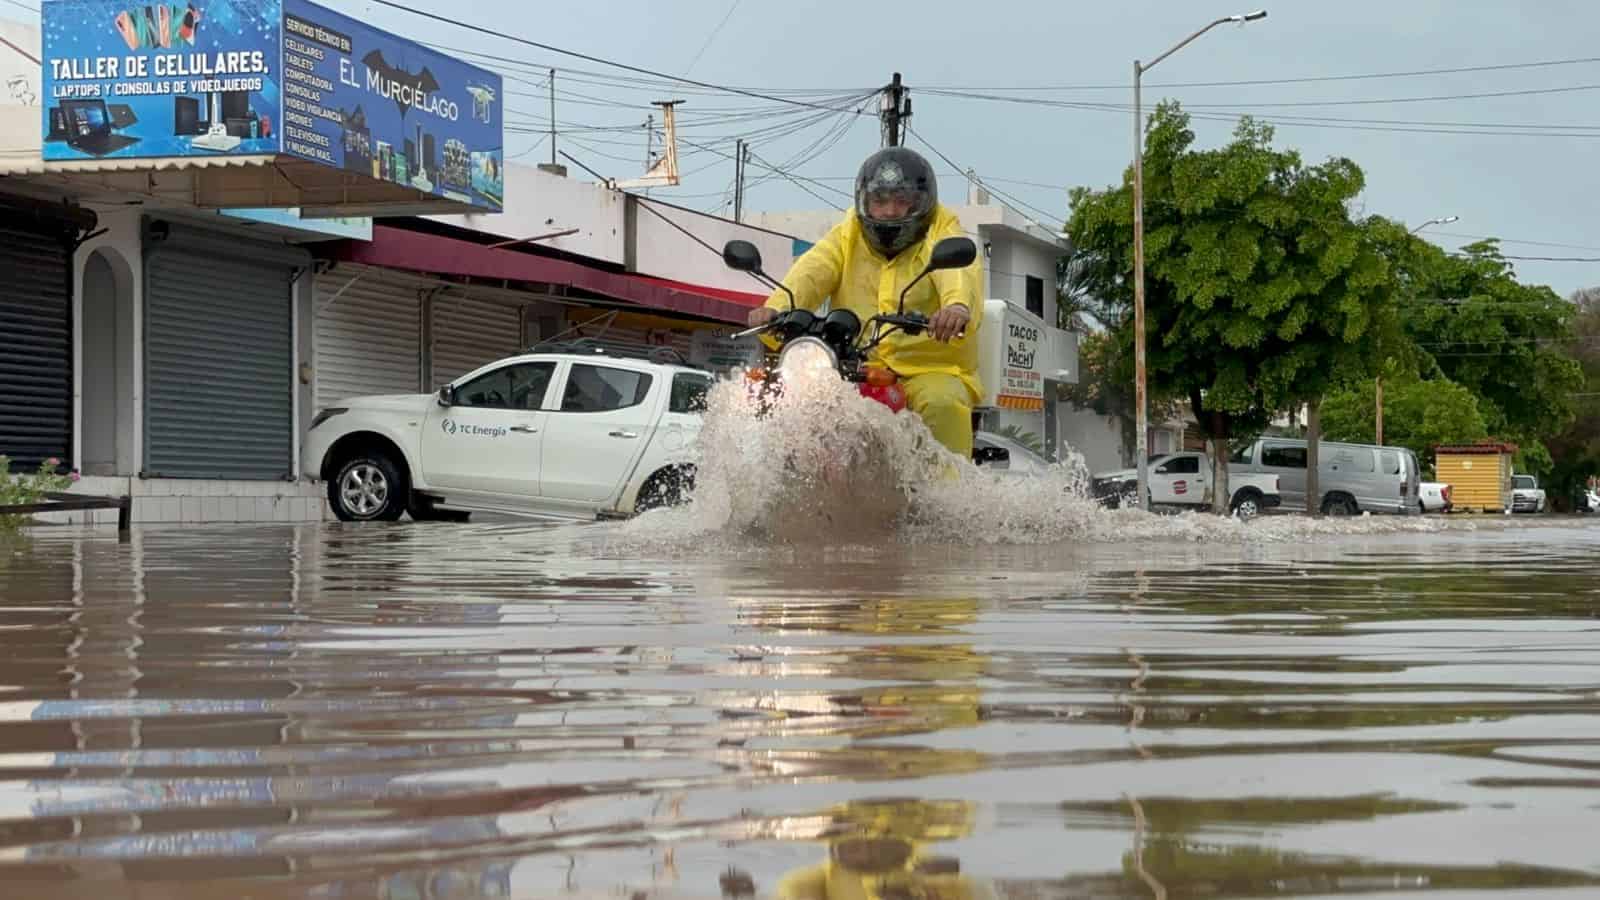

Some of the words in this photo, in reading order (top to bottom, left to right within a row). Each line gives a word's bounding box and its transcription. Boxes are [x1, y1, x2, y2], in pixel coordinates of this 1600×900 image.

[286, 17, 314, 37] SERVICIO
[315, 27, 340, 48] TÉCNICO
[285, 38, 324, 60] CELULARES
[51, 57, 118, 80] TALLER
[126, 56, 147, 77] DE
[155, 51, 268, 76] CELULARES.
[285, 53, 314, 71] TABLETS
[53, 83, 100, 98] LAPTOPS
[104, 83, 111, 95] Y
[115, 81, 170, 95] CONSOLAS
[174, 80, 186, 93] DE
[191, 78, 262, 92] VIDEOJUEGOS
[285, 67, 333, 90] COMPUTADORA
[285, 82, 320, 102] CONSOLAS
[340, 57, 360, 88] EL
[366, 66, 458, 121] MURCIÉLAGO
[285, 97, 305, 111] VIDEO
[307, 103, 342, 122] VIGILANCIA
[285, 111, 313, 128] DRONES
[286, 126, 329, 147] TELEVISORES
[293, 142, 315, 157] MUCHO
[1008, 324, 1038, 341] TACOS
[1008, 344, 1036, 369] PACHY
[1018, 342, 1026, 352] EL
[460, 425, 471, 434] TC
